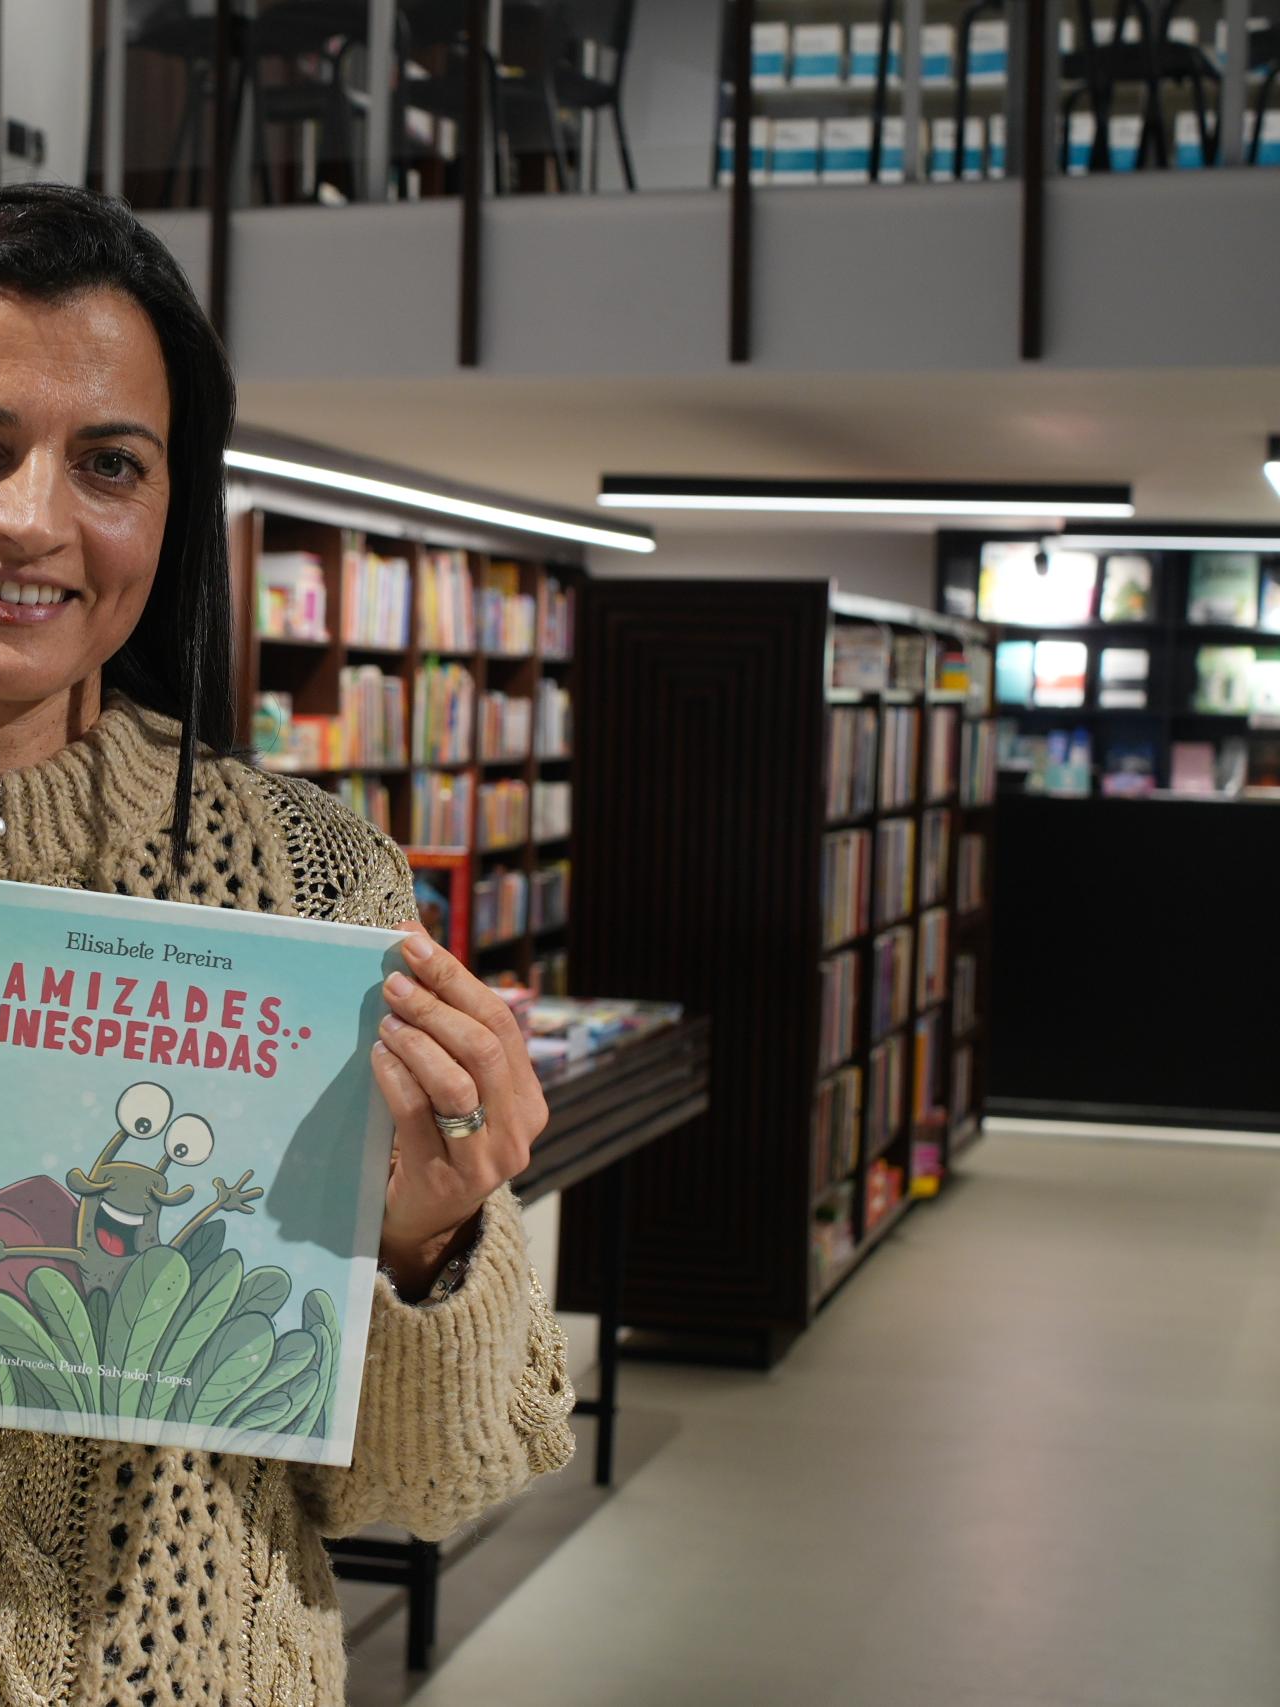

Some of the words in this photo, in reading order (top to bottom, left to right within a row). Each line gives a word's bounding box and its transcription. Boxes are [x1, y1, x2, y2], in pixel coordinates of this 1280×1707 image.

[65, 931, 154, 960] Elisabete
[162, 943, 233, 970] Pereira
[3, 962, 282, 1036] AMIZADES
[59, 1360, 93, 1375] Paulo
[97, 1364, 152, 1381] Salvador
[157, 1371, 192, 1388] Lopes
